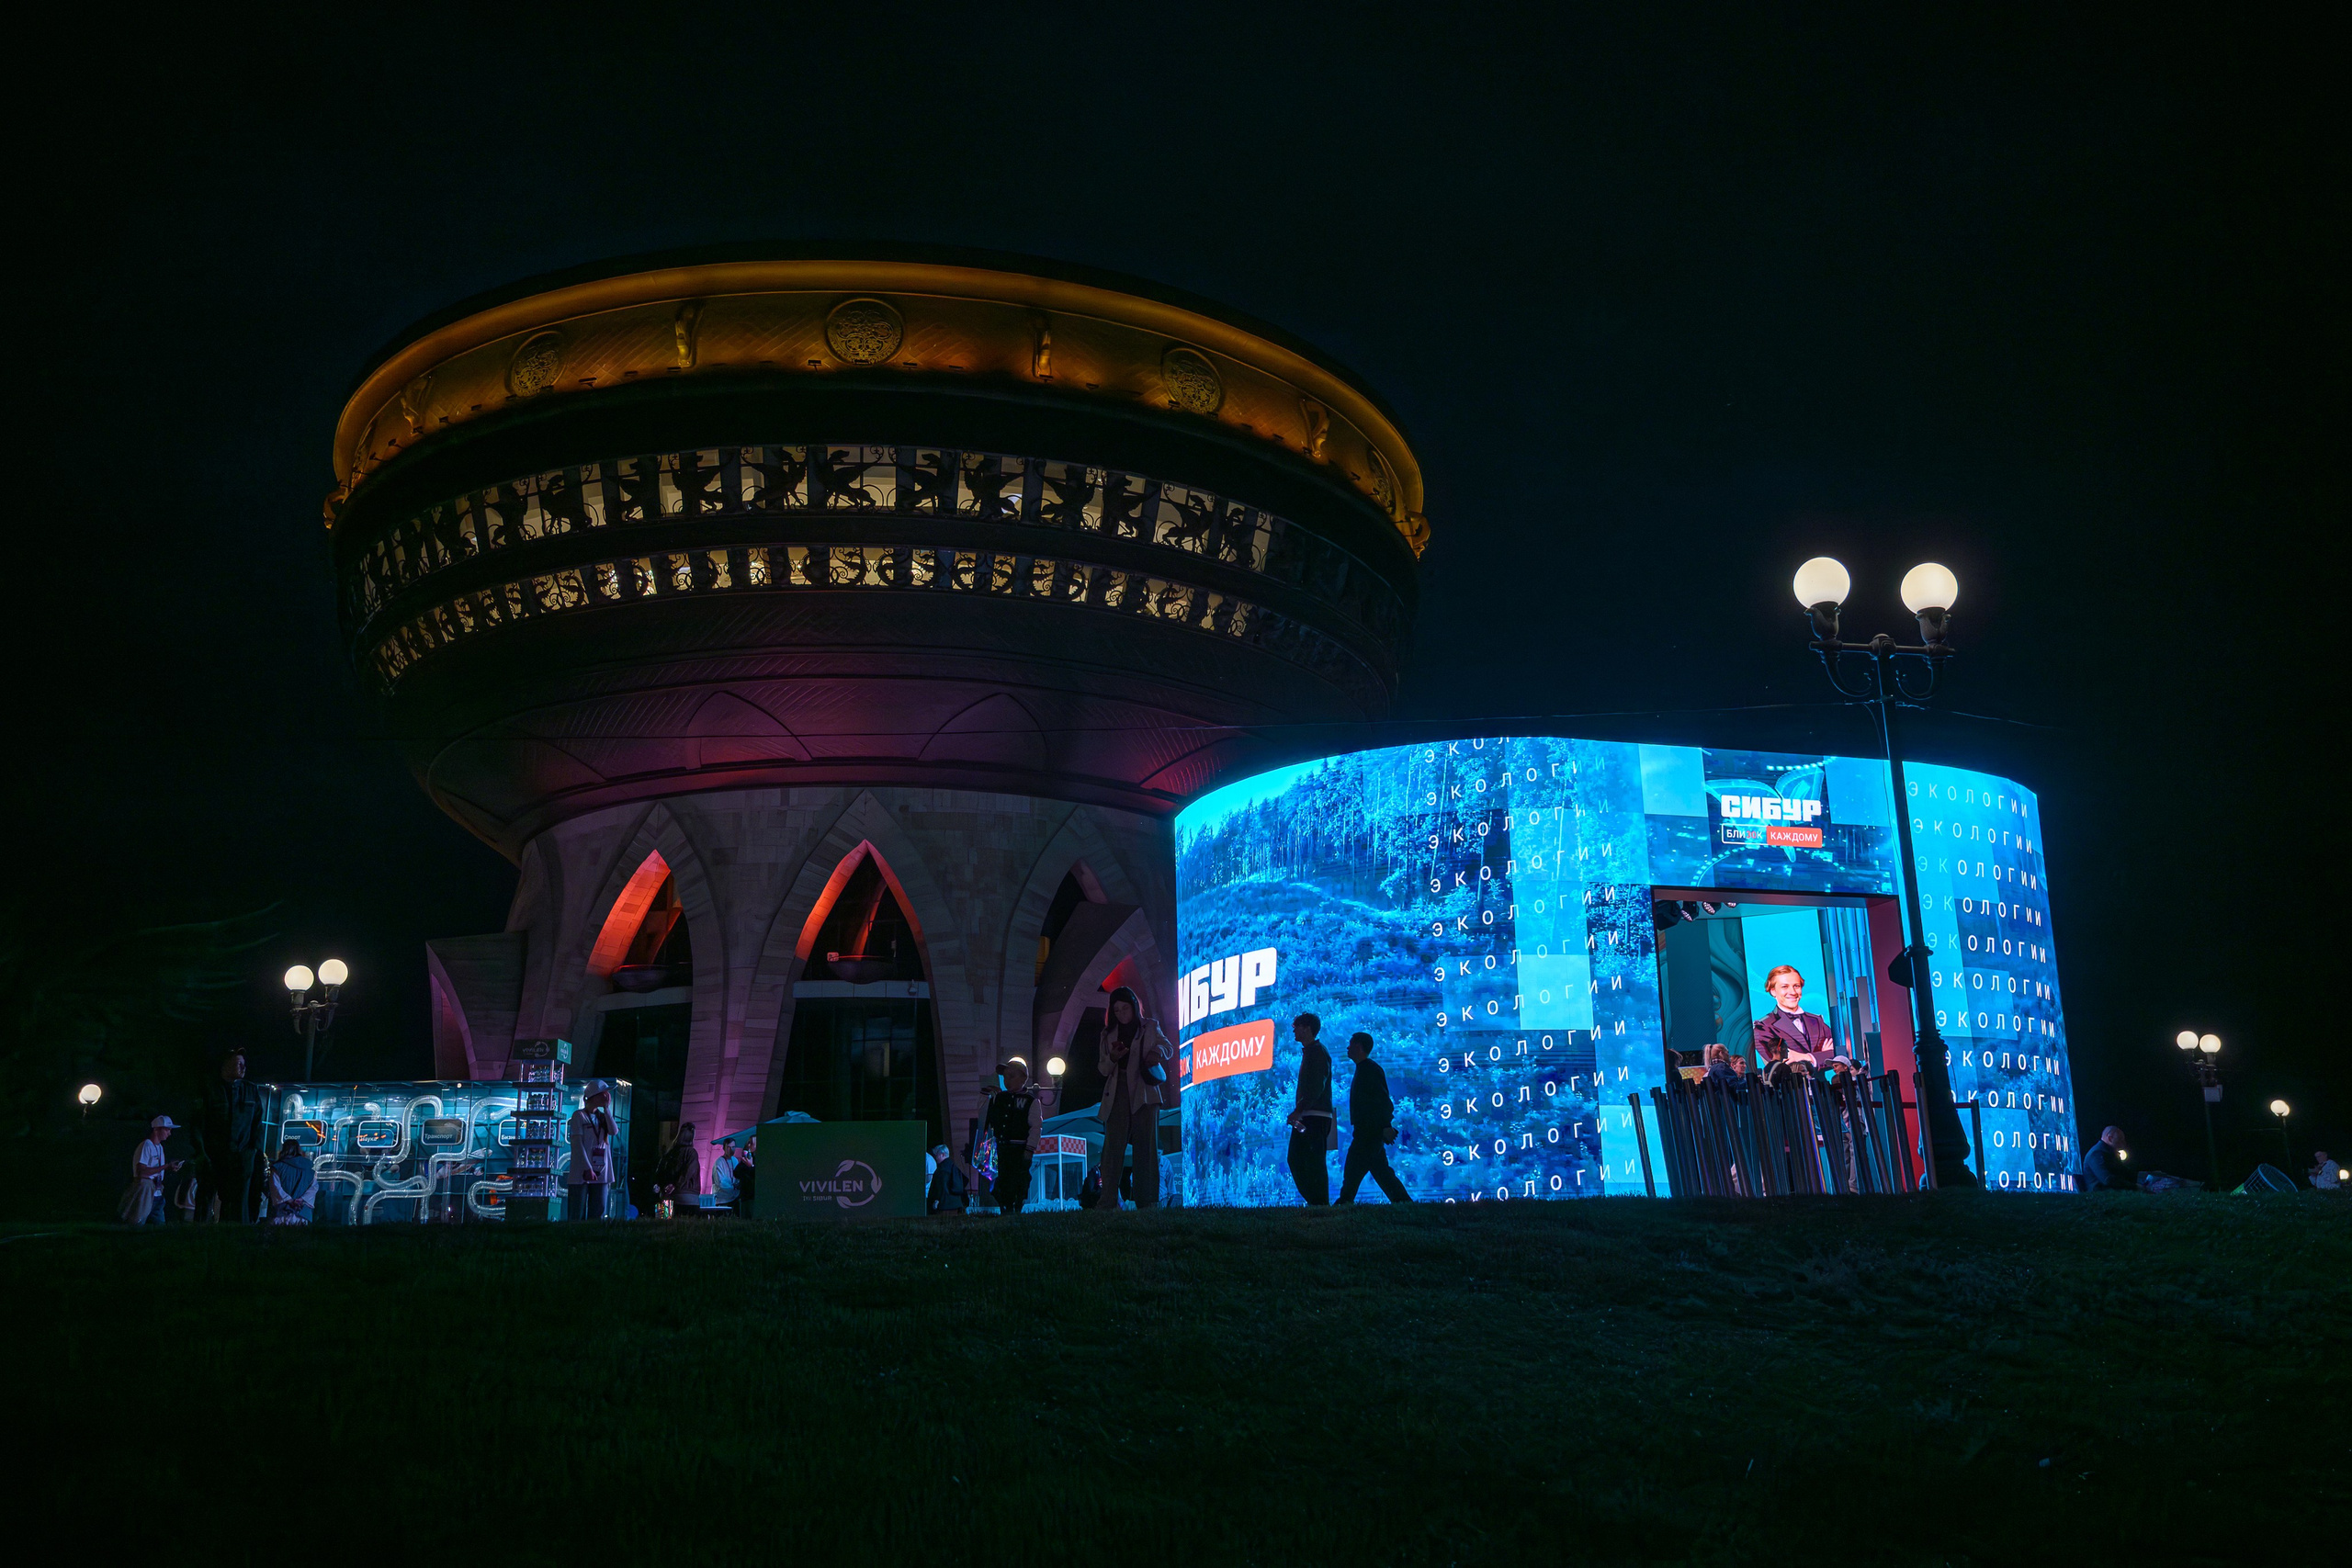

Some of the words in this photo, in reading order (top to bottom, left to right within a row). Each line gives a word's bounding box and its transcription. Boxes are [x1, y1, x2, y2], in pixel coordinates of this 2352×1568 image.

[1426, 756, 1605, 806] ЭКОЛОГИИ
[1721, 795, 1822, 822] СИБУР
[1908, 782, 2028, 818] ЭКОЛОГИИ
[1428, 799, 1609, 849] ЭКОЛОГИИ
[1770, 831, 1818, 842] КАЖДОМУ
[1913, 818, 2032, 854] ЭКОЛОГИИ
[1430, 842, 1612, 893] ЭКОЛОГИИ
[1917, 856, 2037, 890] ЭКОЛОГИИ
[1431, 886, 1615, 937] ЭКОЛОГИИ
[1922, 894, 2041, 927] ЭКОЛОГИИ
[1433, 931, 1619, 982] ЭКОЛОГИИ
[1927, 932, 2046, 964] ЭКОЛОГИИ
[1436, 975, 1622, 1027] ЭКОЛОГИИ
[1932, 971, 2051, 1000] ЭКОЛОГИИ
[1937, 1010, 2055, 1038] ЭКОЛОГИИ
[1196, 1035, 1266, 1069] КАЖДОМУ
[1438, 1021, 1625, 1073] ЭКОЛОГИИ
[1440, 1066, 1629, 1119] ЭКОЛОГИИ
[1442, 1112, 1632, 1166] ЭКОЛОГИИ
[799, 1180, 864, 1192] VIVILEN
